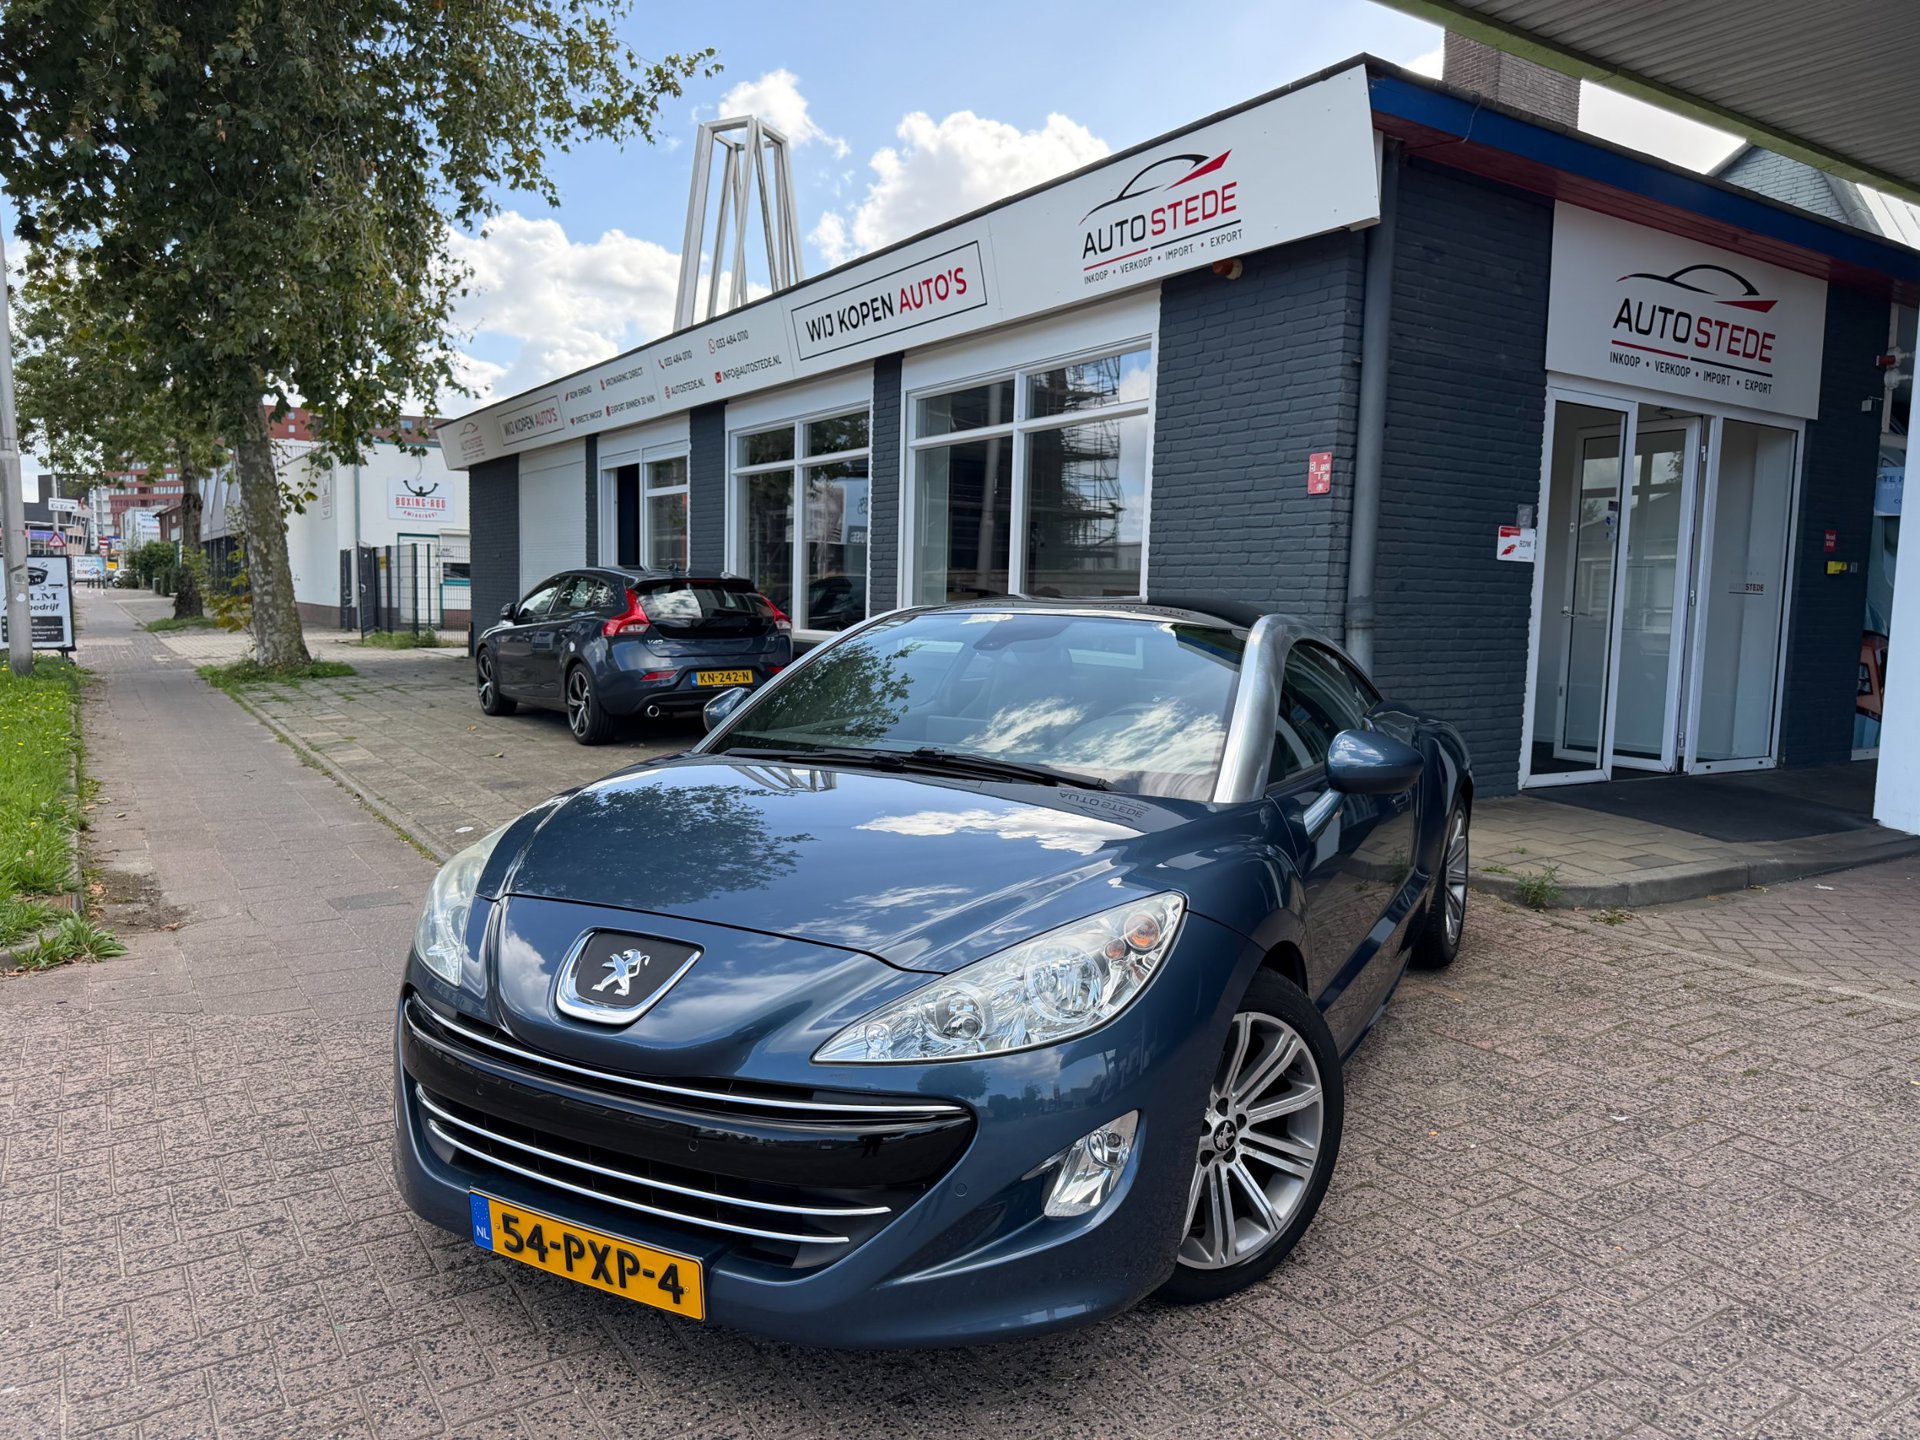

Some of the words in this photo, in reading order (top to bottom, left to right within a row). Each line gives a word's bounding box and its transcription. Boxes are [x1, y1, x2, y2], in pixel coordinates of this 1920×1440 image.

[1084, 270, 1109, 285] INKOOP
[1120, 257, 1153, 274] VERKOOP
[1165, 244, 1193, 261] IMPORT
[1210, 229, 1242, 247] EXPORT
[806, 313, 834, 342] WIJ
[837, 293, 894, 333] KOPEN
[899, 267, 967, 314] AUTO'S
[722, 354, 782, 380] INFO@AUTOSTEDE.NL
[1609, 351, 1641, 368] INKOOP
[1655, 360, 1691, 378] VERKOOP
[1703, 370, 1731, 386] IMPORT
[1745, 379, 1773, 395] EXPORT
[671, 378, 706, 395] AUTOSTEDE.NL
[515, 416, 536, 434] KOPEN
[700, 671, 750, 684] KN-242-N
[476, 1224, 491, 1241] NL
[501, 1212, 685, 1305] 54-PXP-4
